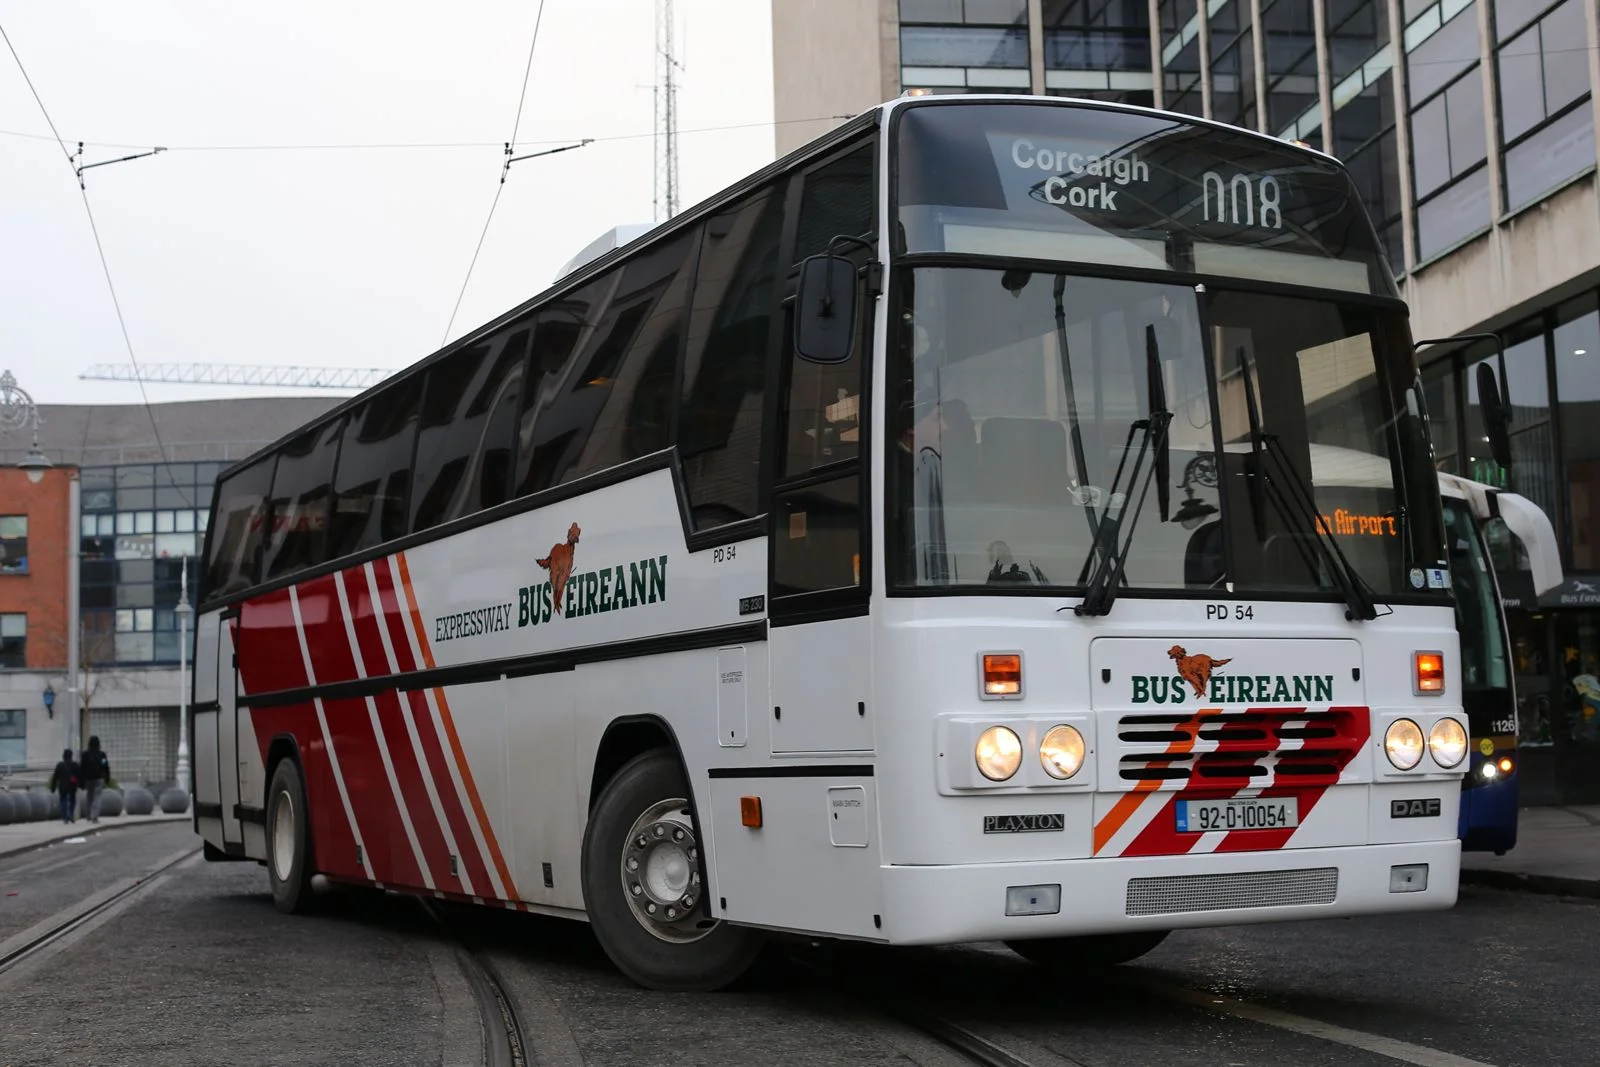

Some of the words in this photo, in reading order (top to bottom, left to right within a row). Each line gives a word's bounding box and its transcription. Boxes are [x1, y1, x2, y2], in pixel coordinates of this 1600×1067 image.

[1011, 138, 1149, 185] Corcaigh
[1044, 176, 1118, 211] Cork
[1334, 508, 1396, 536] Airport
[713, 548, 724, 563] PD
[726, 545, 736, 560] 54
[435, 602, 513, 643] EXPRESSWAY
[518, 581, 552, 628] BUS
[1206, 604, 1229, 620] PD
[1235, 604, 1254, 620] 54
[1131, 676, 1186, 704] BUS
[1199, 805, 1286, 829] 92-D-10054
[1392, 799, 1440, 816] DAF
[984, 813, 1064, 832] PLAXTON
